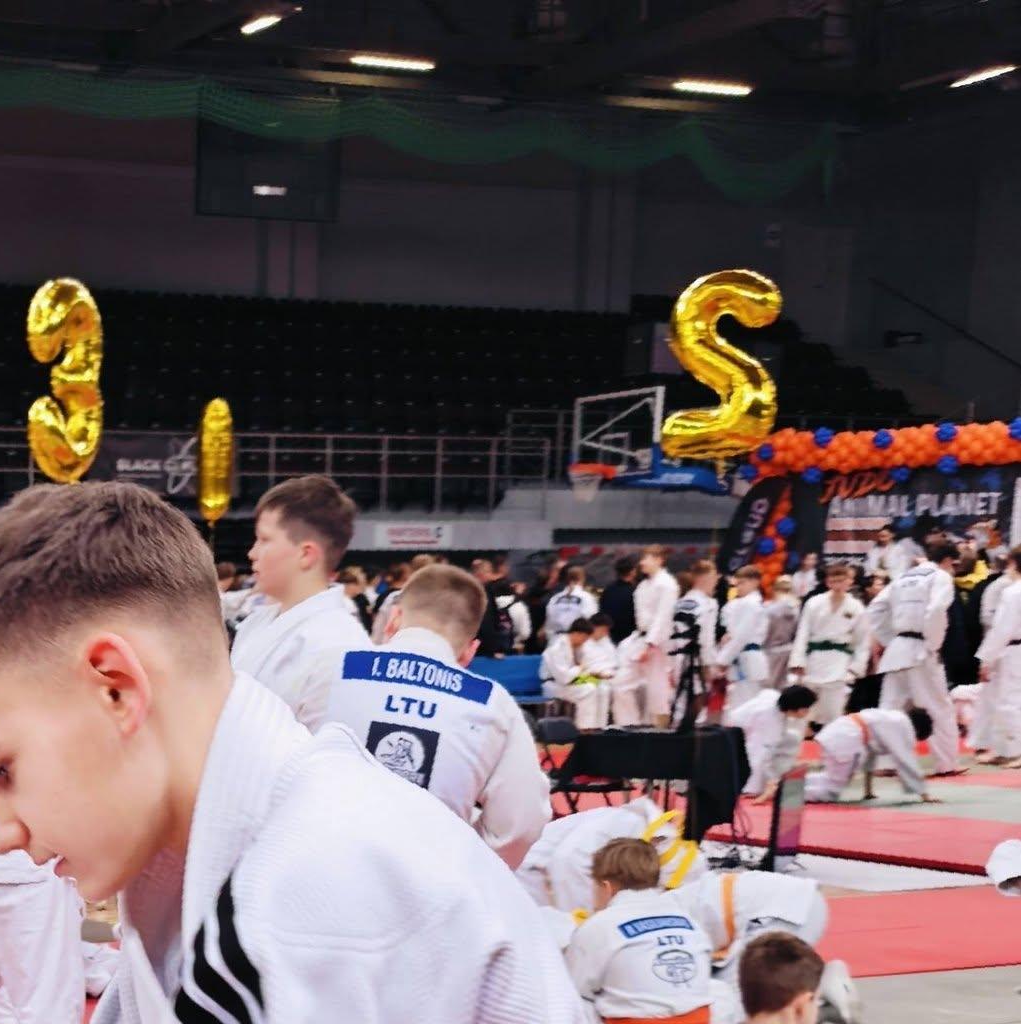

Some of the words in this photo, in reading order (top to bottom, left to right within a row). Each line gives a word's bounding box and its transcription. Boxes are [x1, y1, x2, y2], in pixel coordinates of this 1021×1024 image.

[116, 458, 161, 471] BLACK
[914, 491, 1002, 517] PLANET
[386, 658, 463, 692] BALTONIS
[384, 695, 438, 719] LTU
[656, 934, 685, 946] LTU
